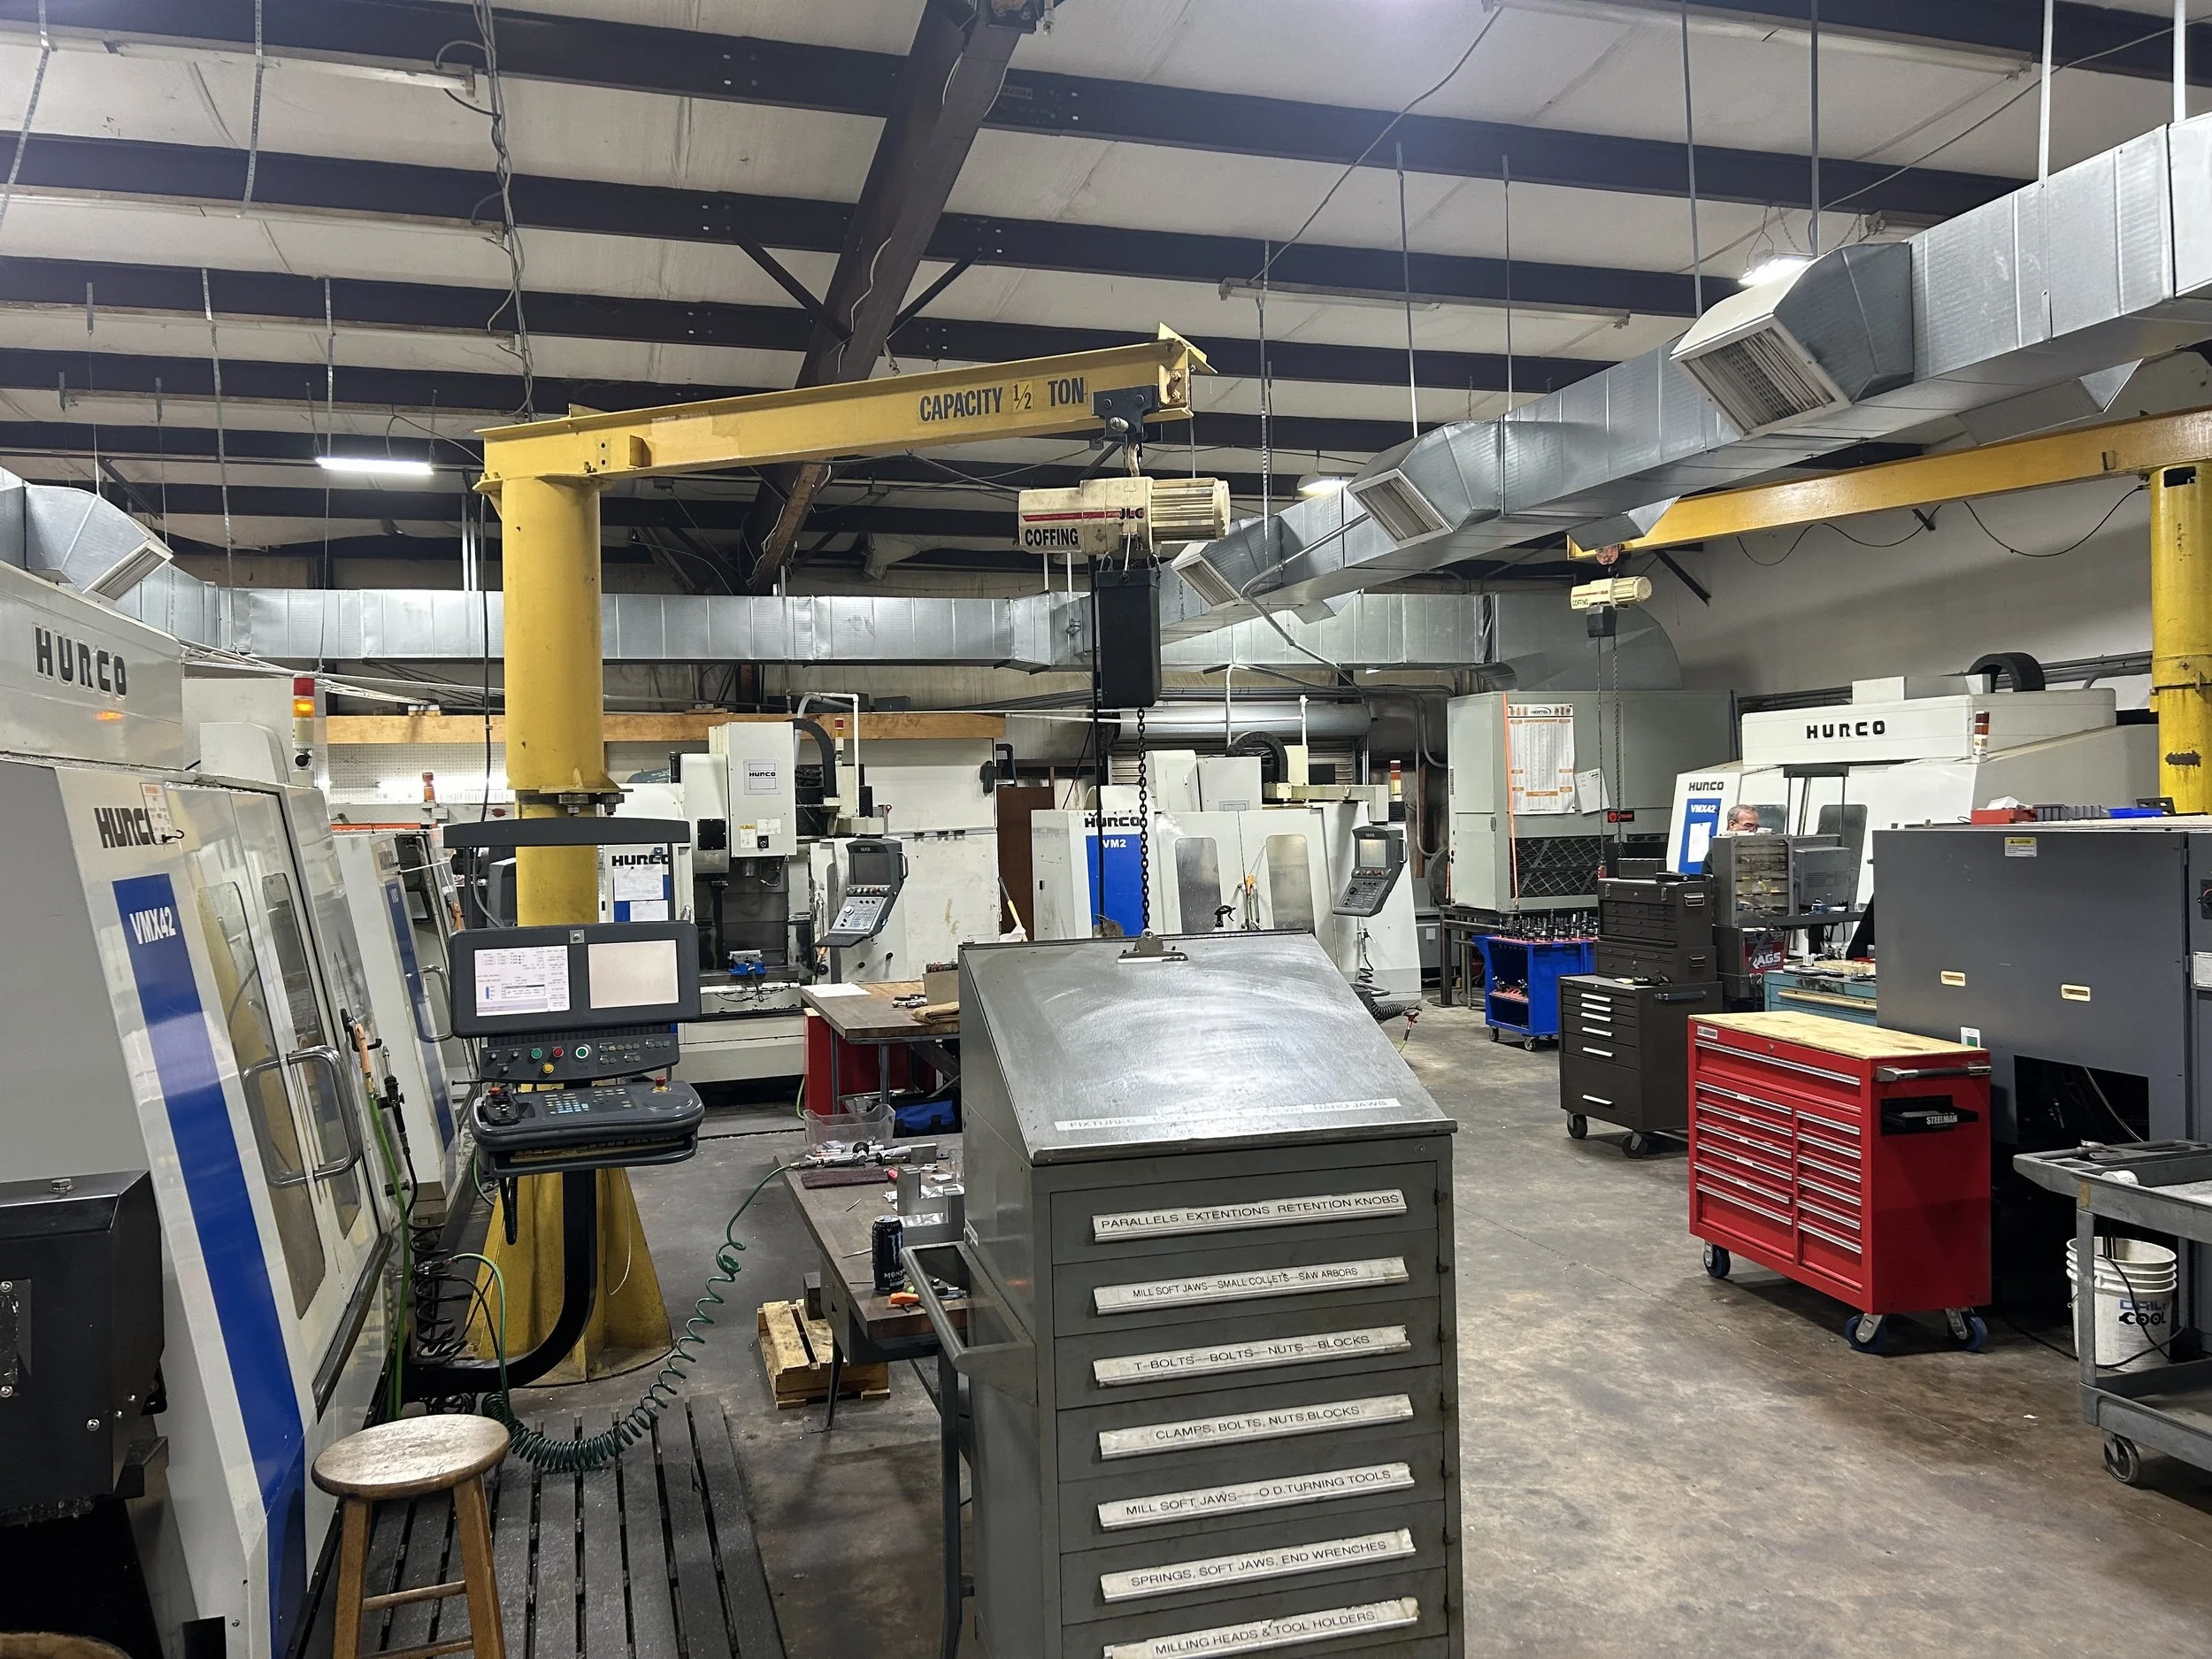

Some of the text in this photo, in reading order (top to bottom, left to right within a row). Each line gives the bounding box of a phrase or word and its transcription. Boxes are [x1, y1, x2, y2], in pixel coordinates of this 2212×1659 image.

[920, 388, 1002, 422] CAPACITY
[1048, 377, 1084, 406] TON
[1119, 508, 1144, 519] JLC
[1025, 528, 1079, 546] COFFING
[35, 626, 127, 695] HURCO
[1807, 720, 1885, 739] HURCO
[1688, 781, 1724, 791] HURCO
[1691, 804, 1717, 813] VMX42
[1085, 817, 1141, 828] HURCO
[129, 906, 177, 945] VMX42
[1926, 1115, 1957, 1125] STEELMAN
[1102, 1194, 1399, 1228] PARALLELS EXTENTIONS RETENTION KNOBS
[1133, 1288, 1154, 1297] MILL
[1156, 1285, 1179, 1294] SOFT
[1322, 1267, 1358, 1277] ARBORS
[2119, 1311, 2167, 1325] COOL
[1156, 1425, 1215, 1440] CLAMPS,
[1218, 1418, 1265, 1432] BOLTS,
[1126, 1505, 1156, 1516] MILL
[1160, 1498, 1195, 1511] SOFT
[1348, 1470, 1391, 1484] TOOLS
[1132, 1540, 1386, 1586] SPRINGS, SOFT JAWS, END WRENCHES
[1156, 1610, 1375, 1655] MILLING HEADS & TOOL HOLDERS
